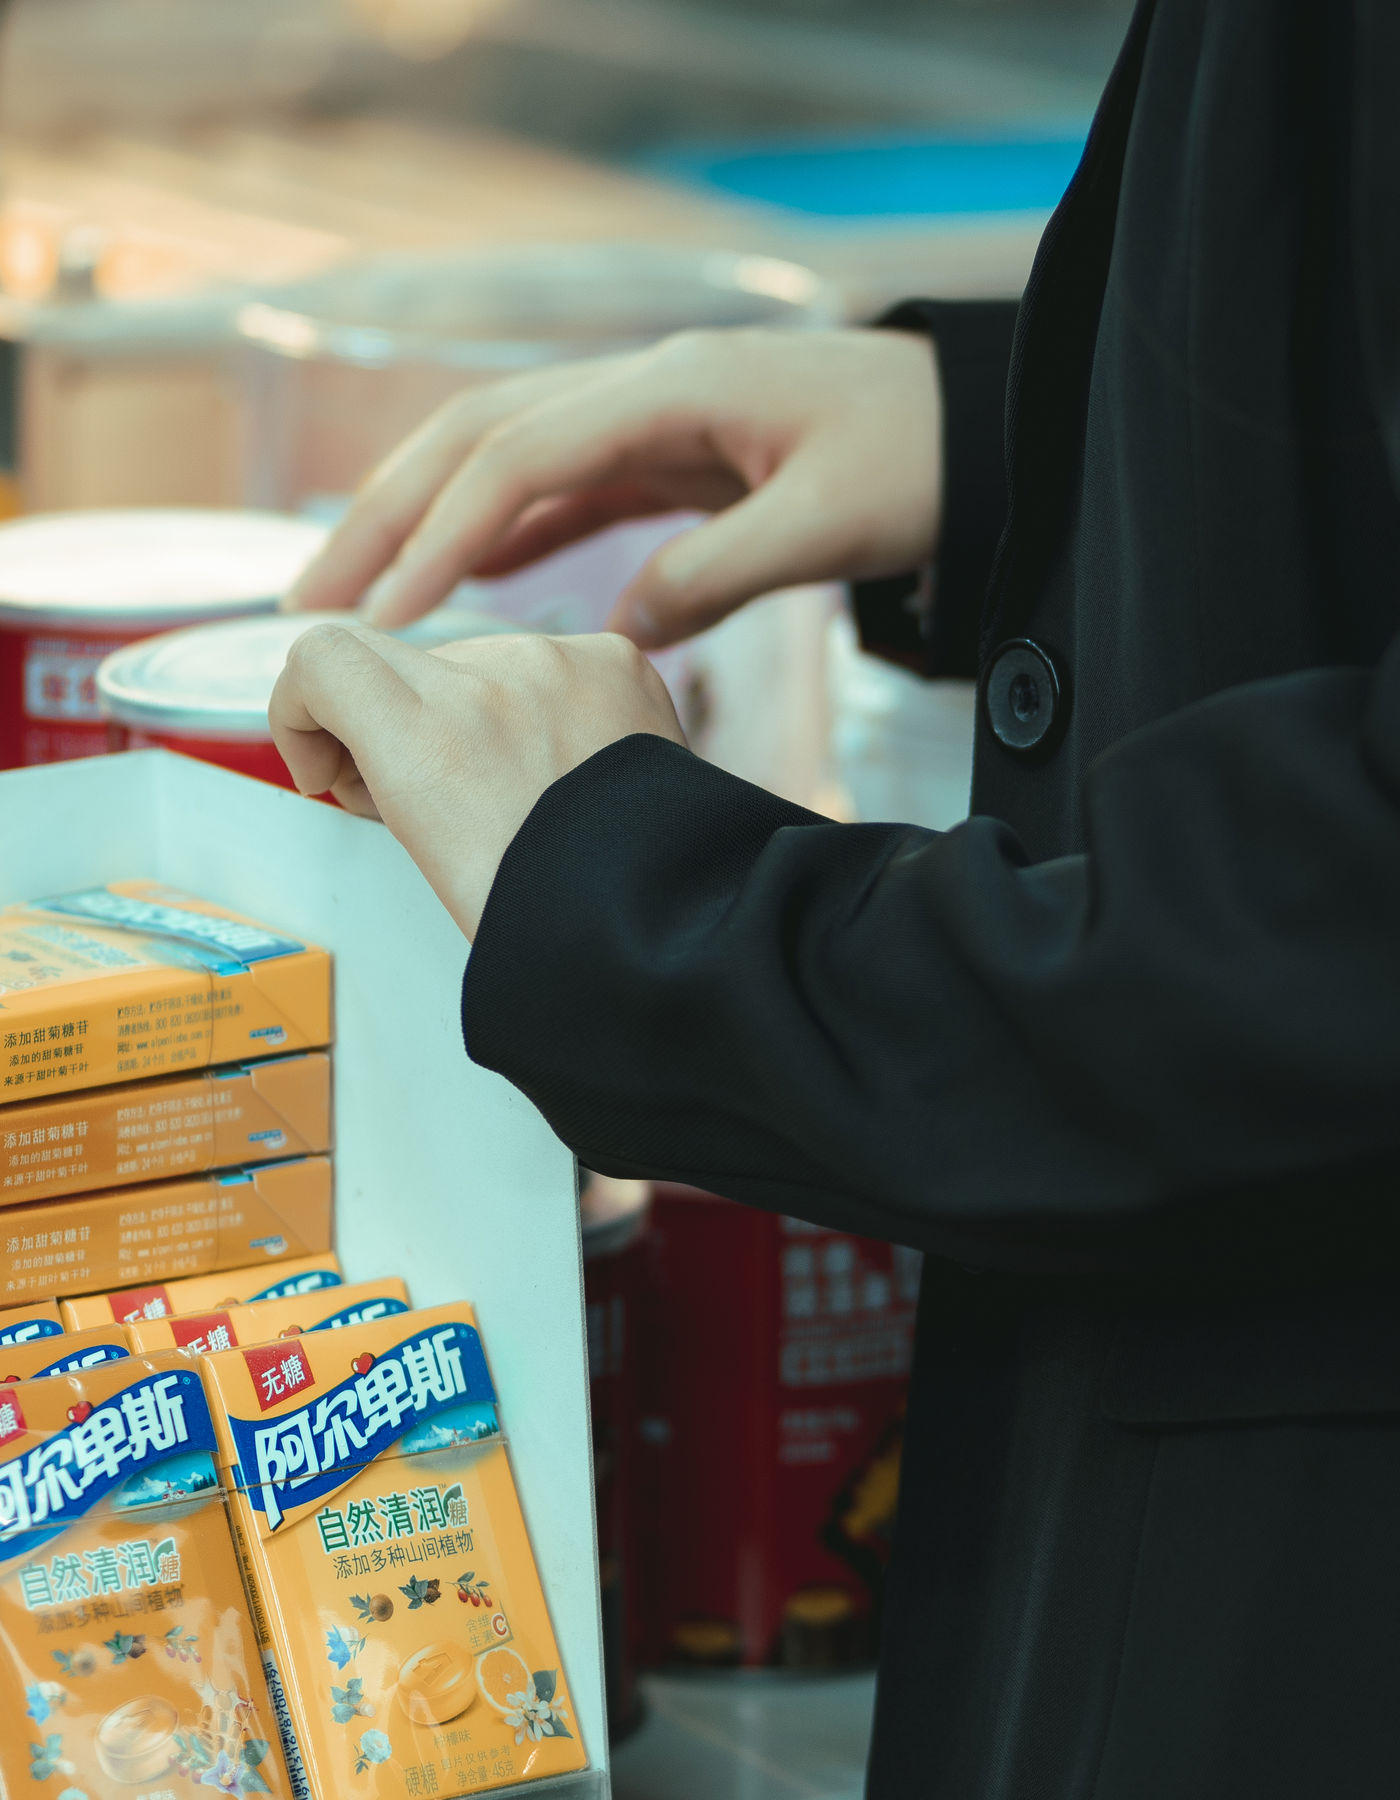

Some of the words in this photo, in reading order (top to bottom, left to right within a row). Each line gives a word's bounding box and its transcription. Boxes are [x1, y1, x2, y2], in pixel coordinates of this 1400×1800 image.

[3, 1020, 89, 1049] 添加甜菊糖苷
[9, 1043, 84, 1067] 添加的甜菊糖苷
[3, 1061, 89, 1087] 来源于甜叶菊干叶
[3, 1121, 89, 1149] 添加甜菊糖苷
[261, 1354, 307, 1401] 无糖
[254, 1327, 468, 1531] 阿尔卑斯
[403, 1761, 440, 1797] 硬糖
